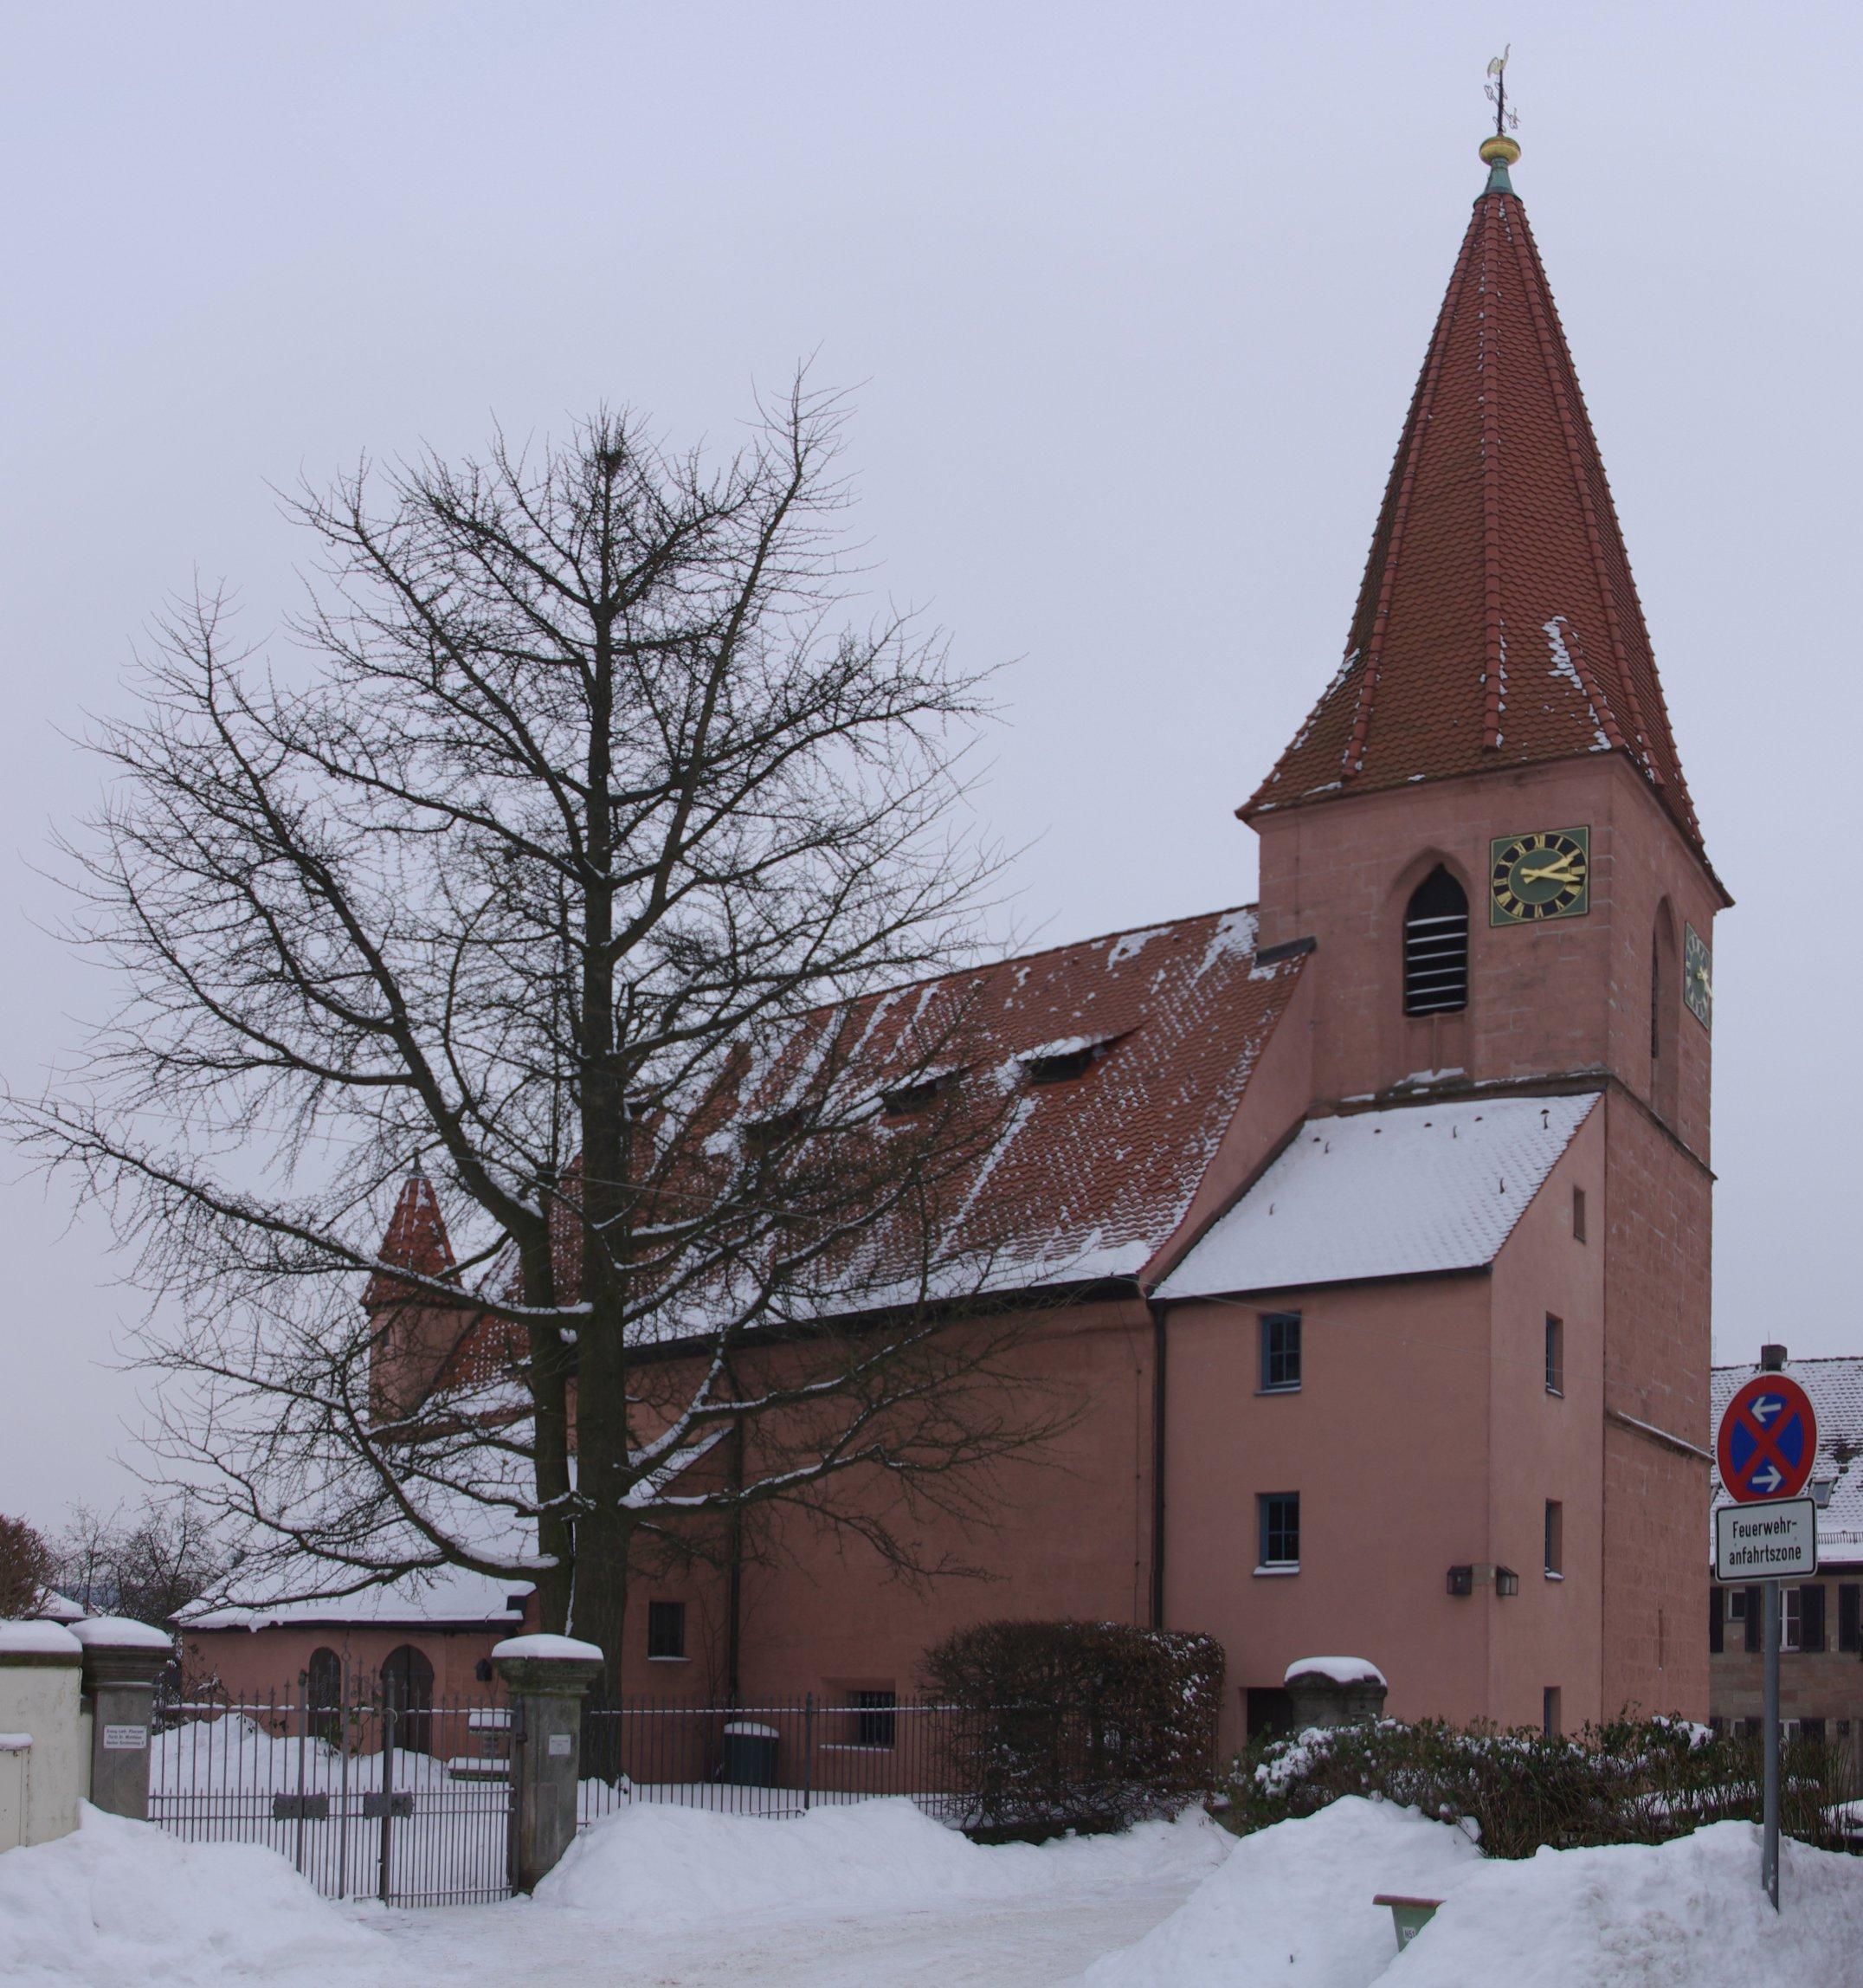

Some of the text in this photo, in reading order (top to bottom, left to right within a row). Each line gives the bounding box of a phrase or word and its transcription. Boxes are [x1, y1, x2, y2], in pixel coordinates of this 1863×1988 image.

[1499, 859, 1513, 868] X
[1554, 899, 1565, 911] V
[1732, 1516, 1797, 1539] Feuerwehr-
[1729, 1545, 1802, 1565] anfahrtszone
